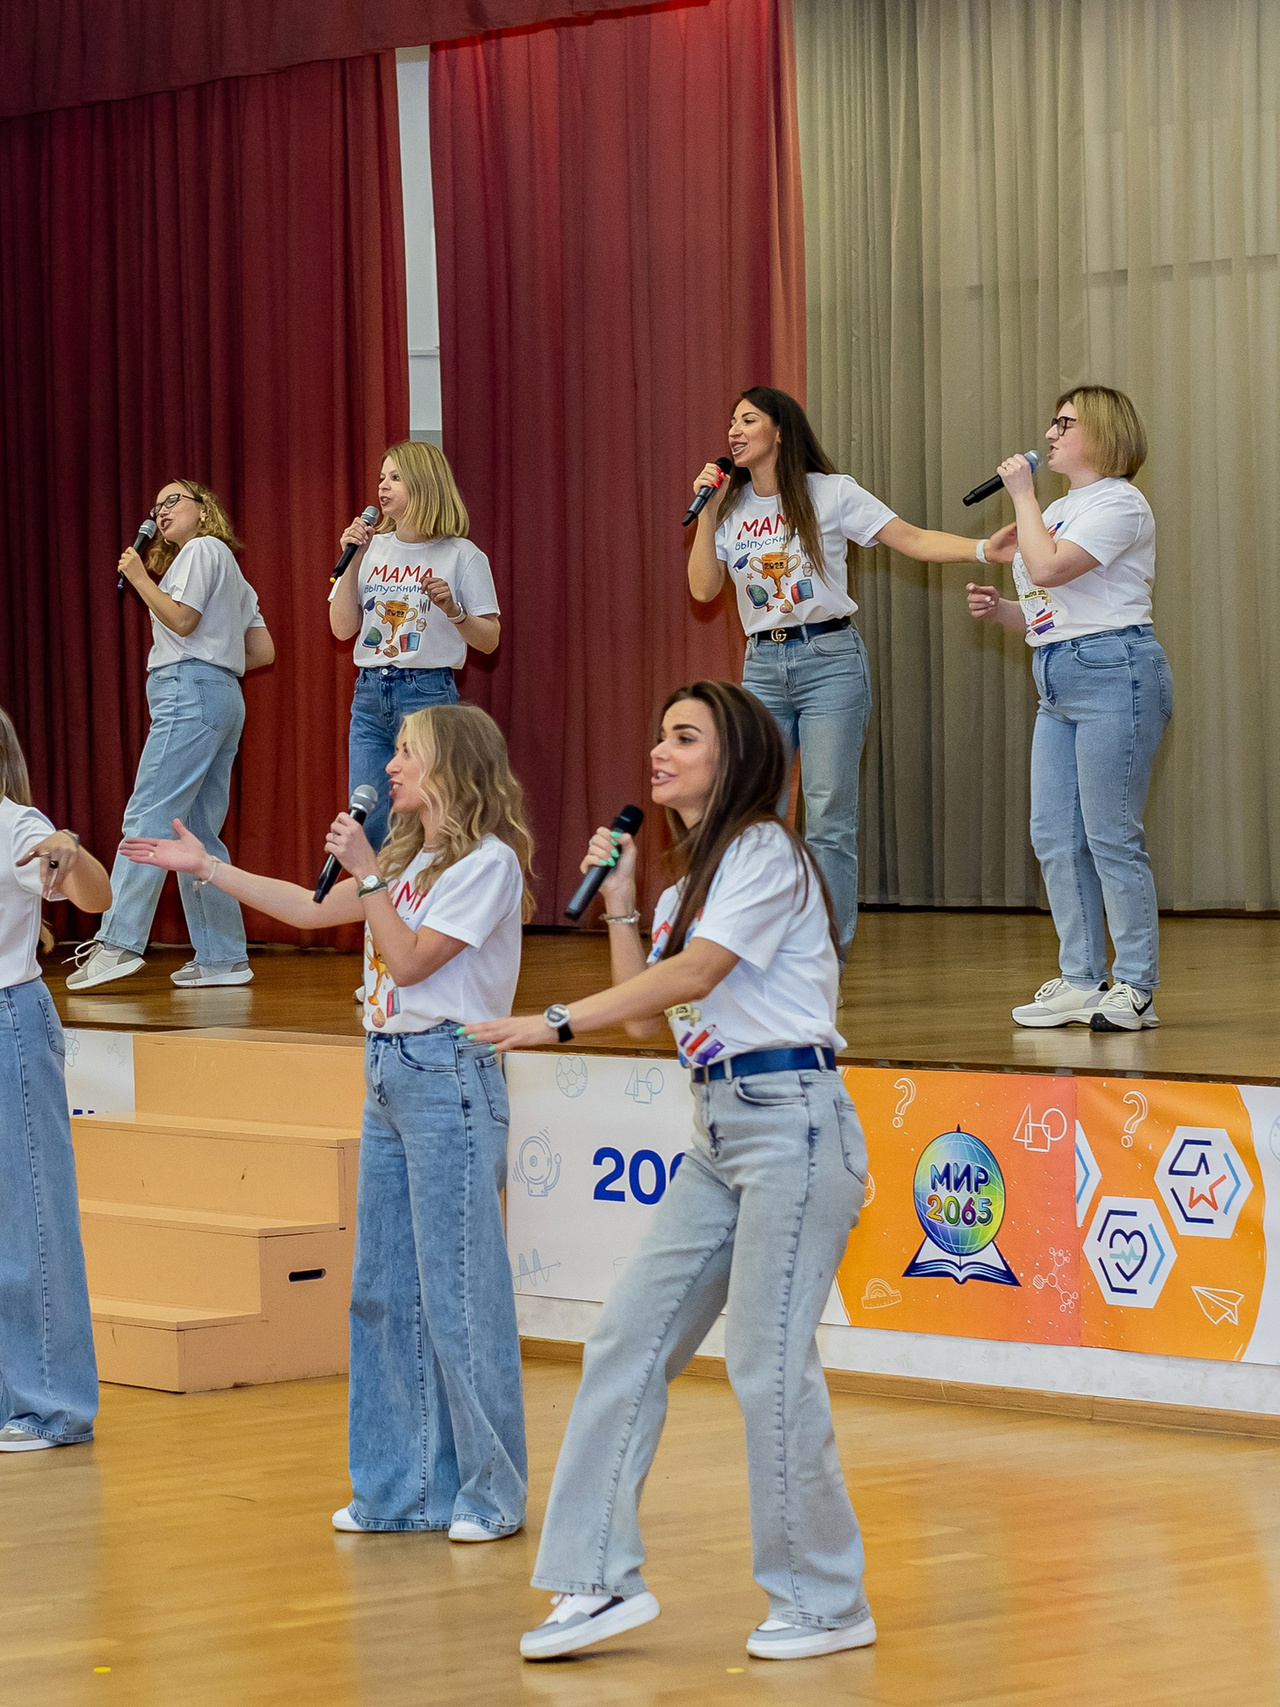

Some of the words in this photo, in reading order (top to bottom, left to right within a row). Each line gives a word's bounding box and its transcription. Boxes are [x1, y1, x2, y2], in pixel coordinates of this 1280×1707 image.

[592, 1146, 686, 1206] 20
[930, 1162, 990, 1194] МИР
[926, 1194, 994, 1227] 2065
